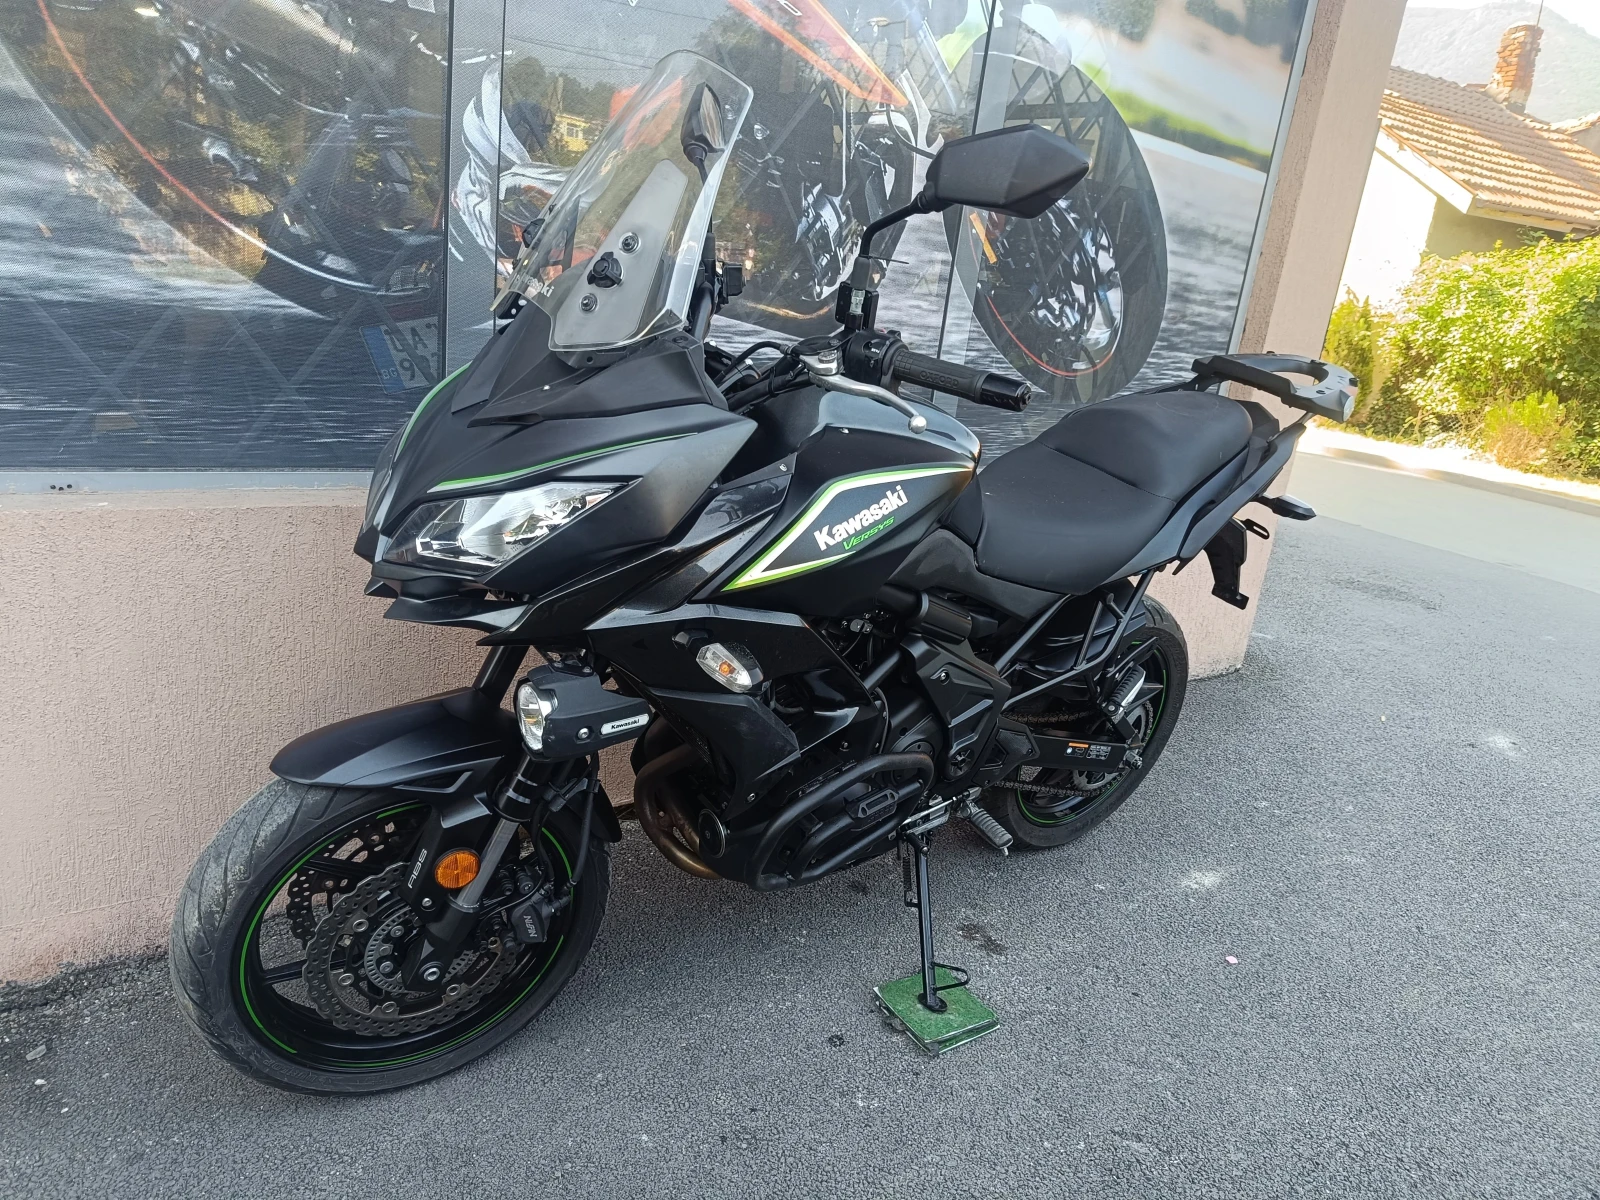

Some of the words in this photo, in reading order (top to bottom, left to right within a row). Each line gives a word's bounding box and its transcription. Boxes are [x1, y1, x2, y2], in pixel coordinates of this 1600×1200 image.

[381, 367, 398, 380] BG
[919, 370, 959, 389] OXFORD
[813, 484, 909, 551] Kawasaki
[842, 516, 895, 550] VERSYS
[610, 718, 640, 730] Kawasaki
[407, 848, 428, 889] ABS
